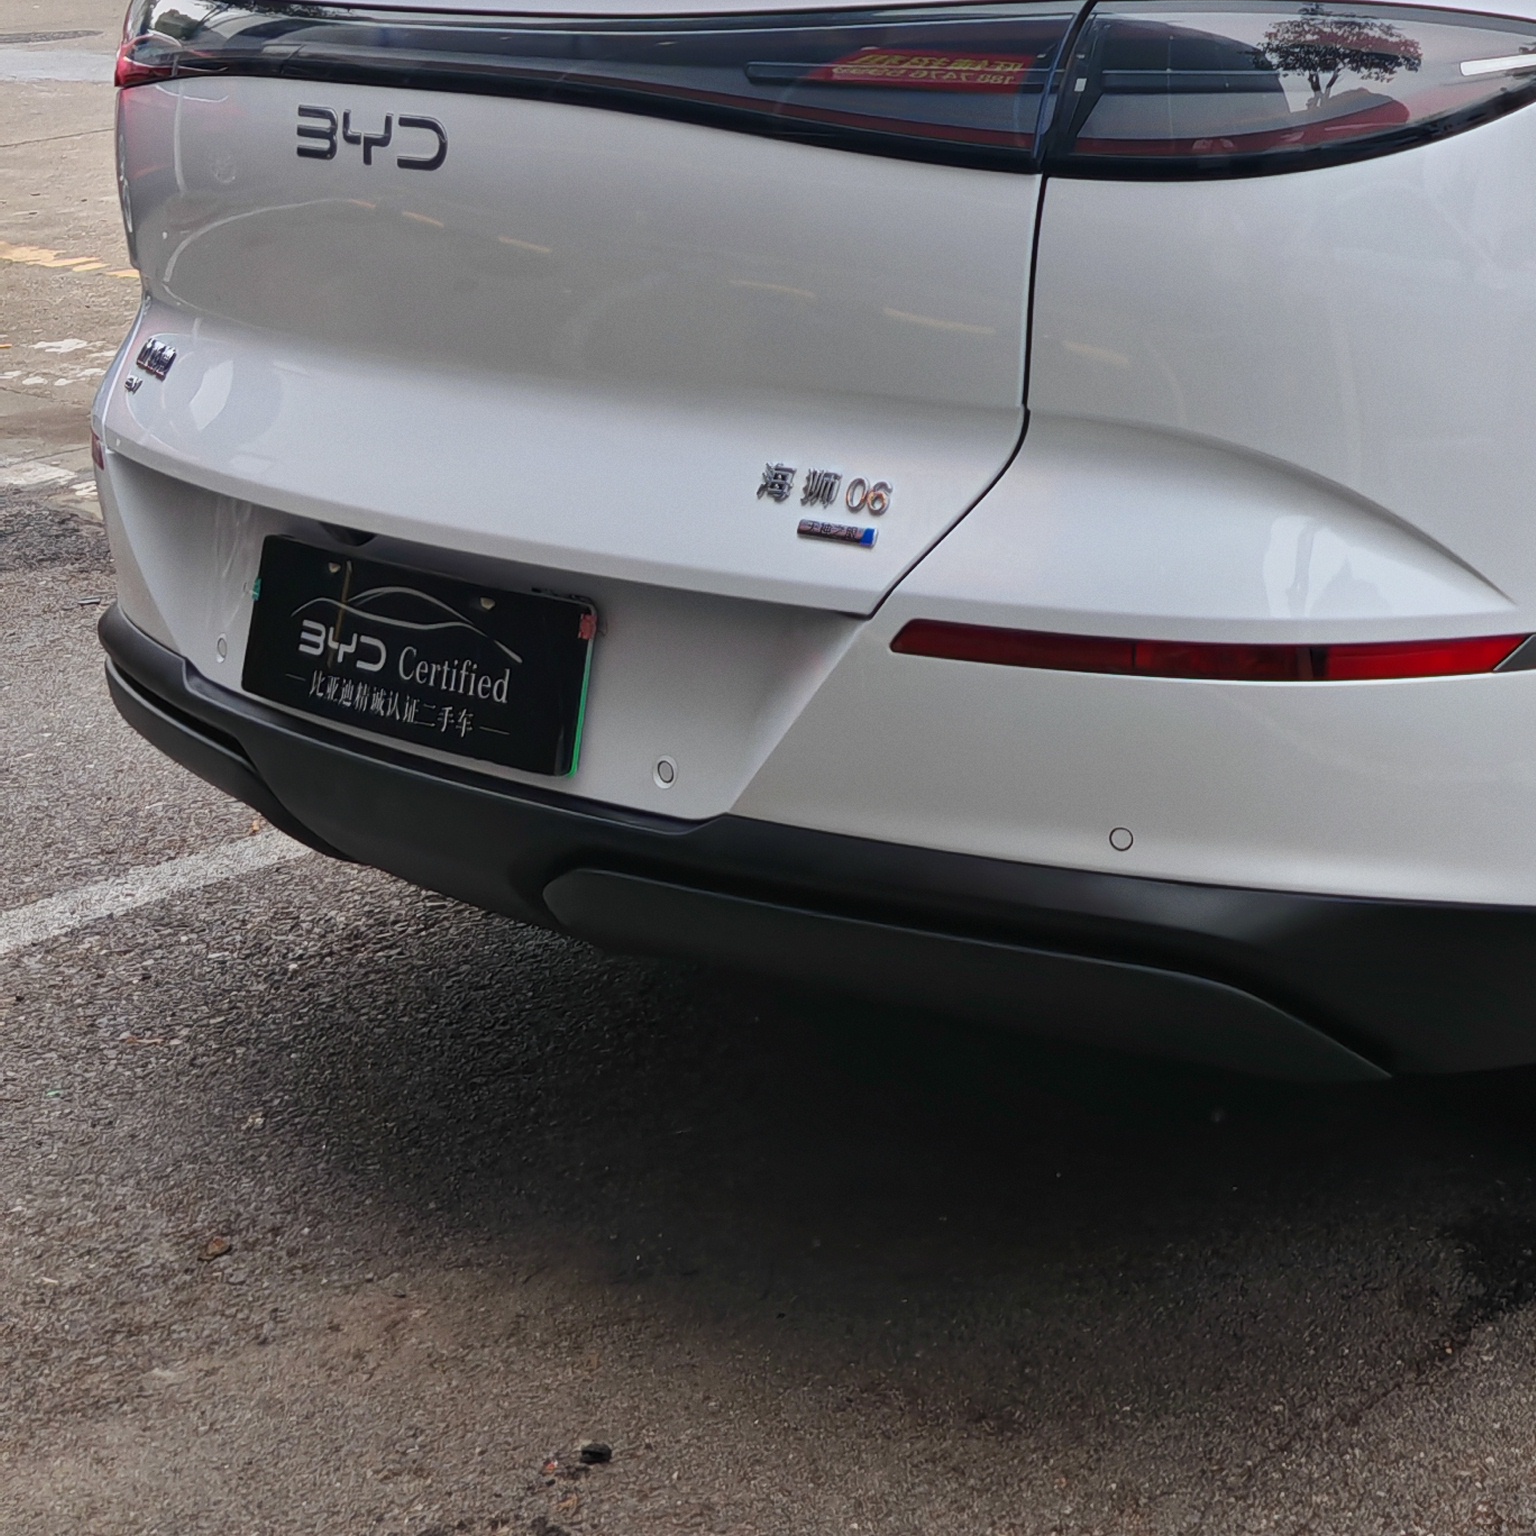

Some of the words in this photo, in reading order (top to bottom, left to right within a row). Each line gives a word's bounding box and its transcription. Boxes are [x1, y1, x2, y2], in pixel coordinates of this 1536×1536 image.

[296, 104, 449, 171] BYD
[298, 619, 387, 673] BYD
[398, 645, 511, 704] Certified
[308, 669, 476, 738] 比亚迪精诚认证二手车
